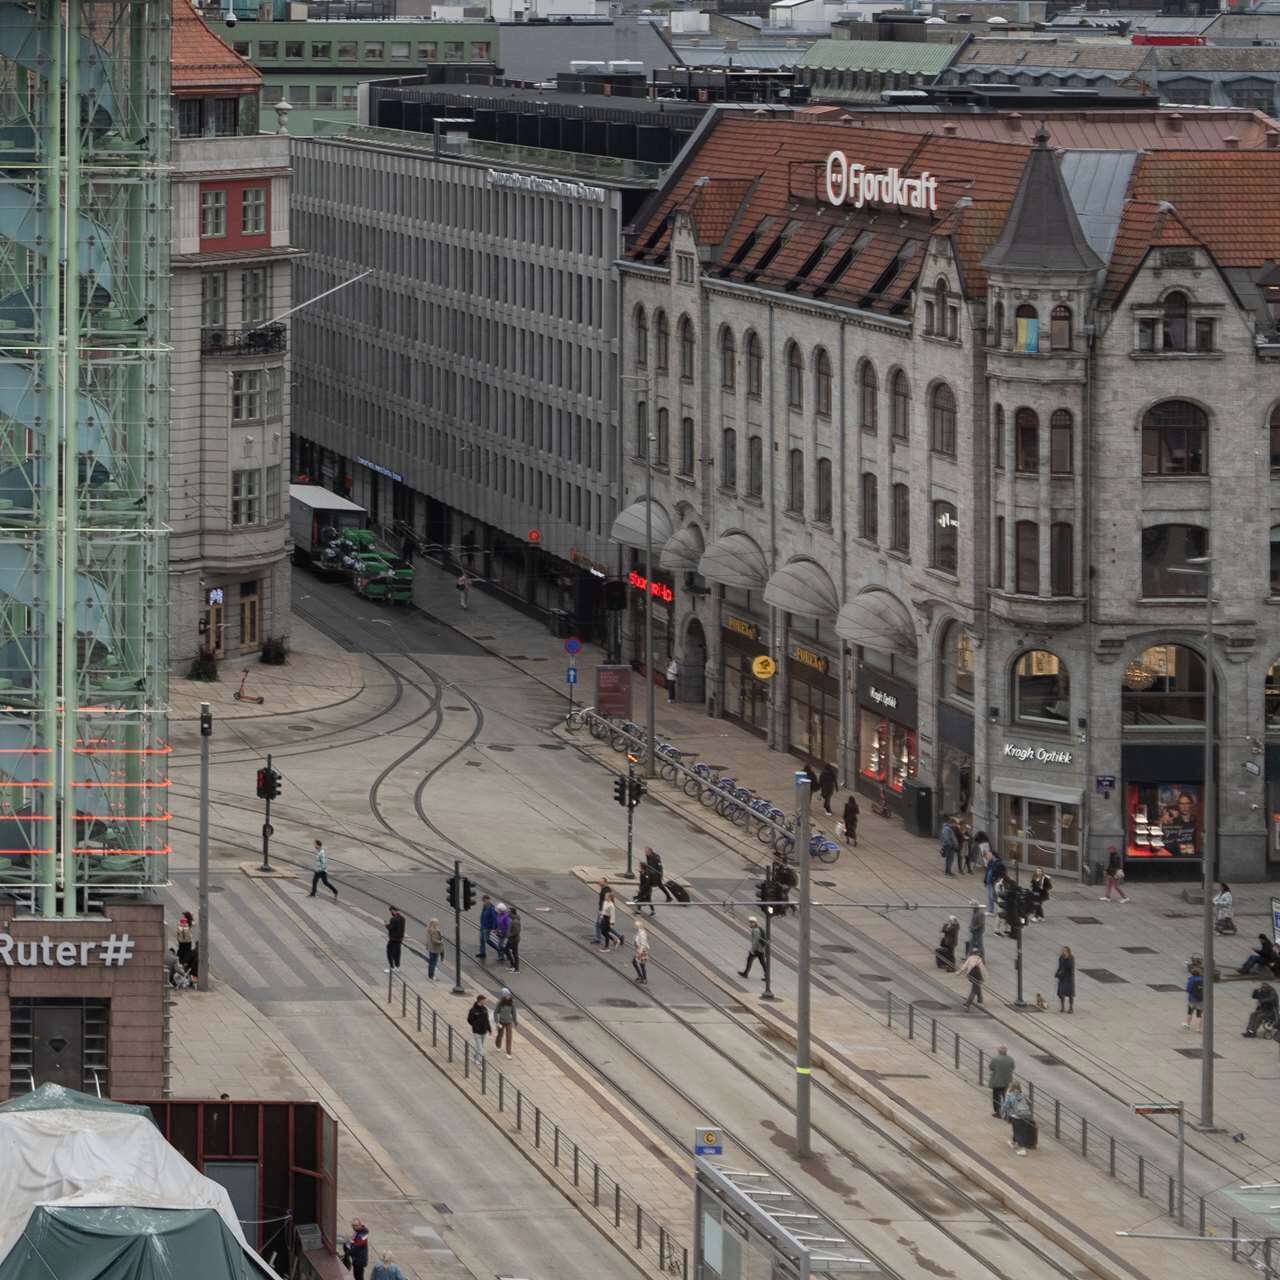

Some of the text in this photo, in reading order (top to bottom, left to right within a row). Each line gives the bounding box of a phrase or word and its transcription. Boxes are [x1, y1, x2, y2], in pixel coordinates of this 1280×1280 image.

[849, 163, 938, 210] Fjordkraft
[1004, 743, 1072, 763] Krogh Optikk
